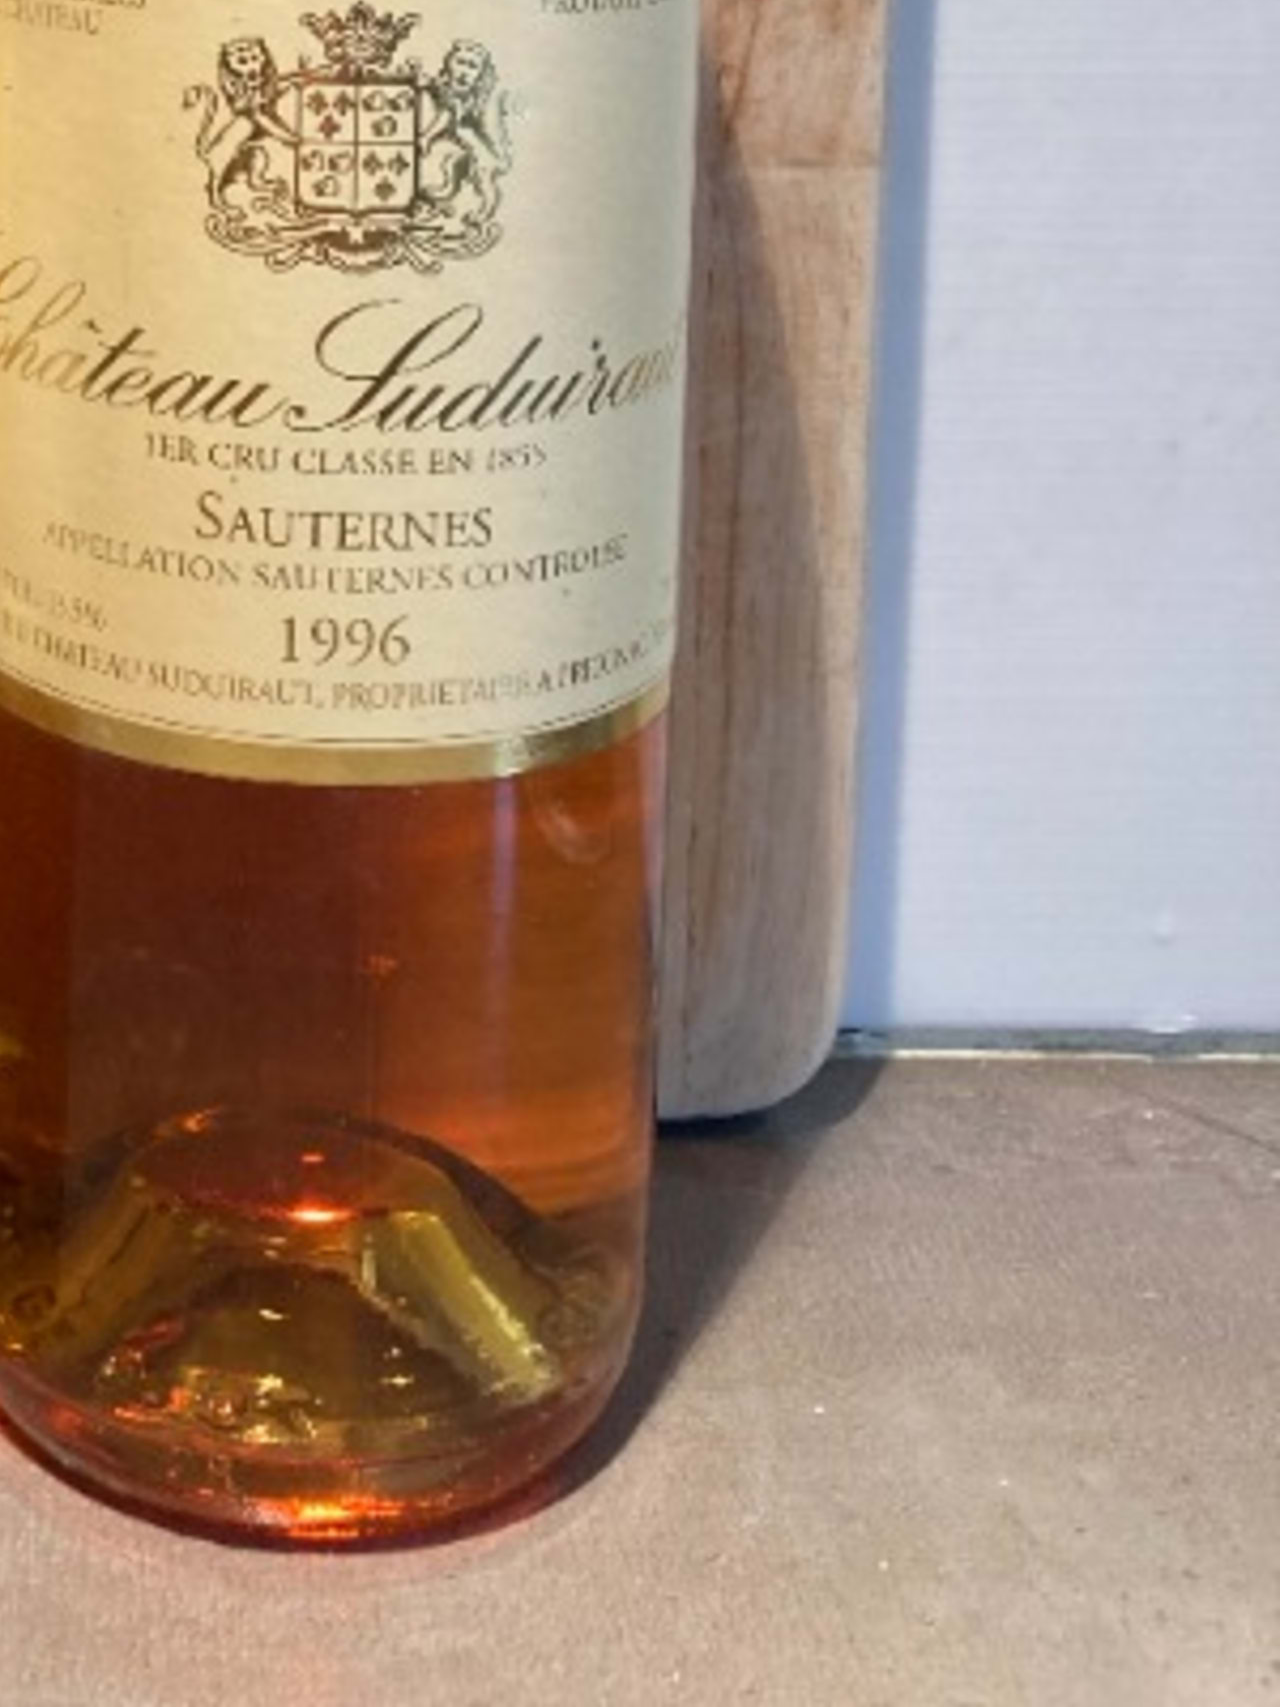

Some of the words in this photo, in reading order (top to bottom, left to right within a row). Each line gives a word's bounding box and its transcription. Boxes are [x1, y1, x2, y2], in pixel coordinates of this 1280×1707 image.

[147, 431, 202, 467] 1ER
[208, 441, 280, 472] CRU
[291, 446, 418, 476] CLASSE
[429, 446, 475, 472] EN
[195, 491, 493, 552] SAUTERNES
[43, 522, 241, 584] APPELLATION
[254, 561, 454, 596] SAUTERNES
[281, 614, 412, 668] 1996
